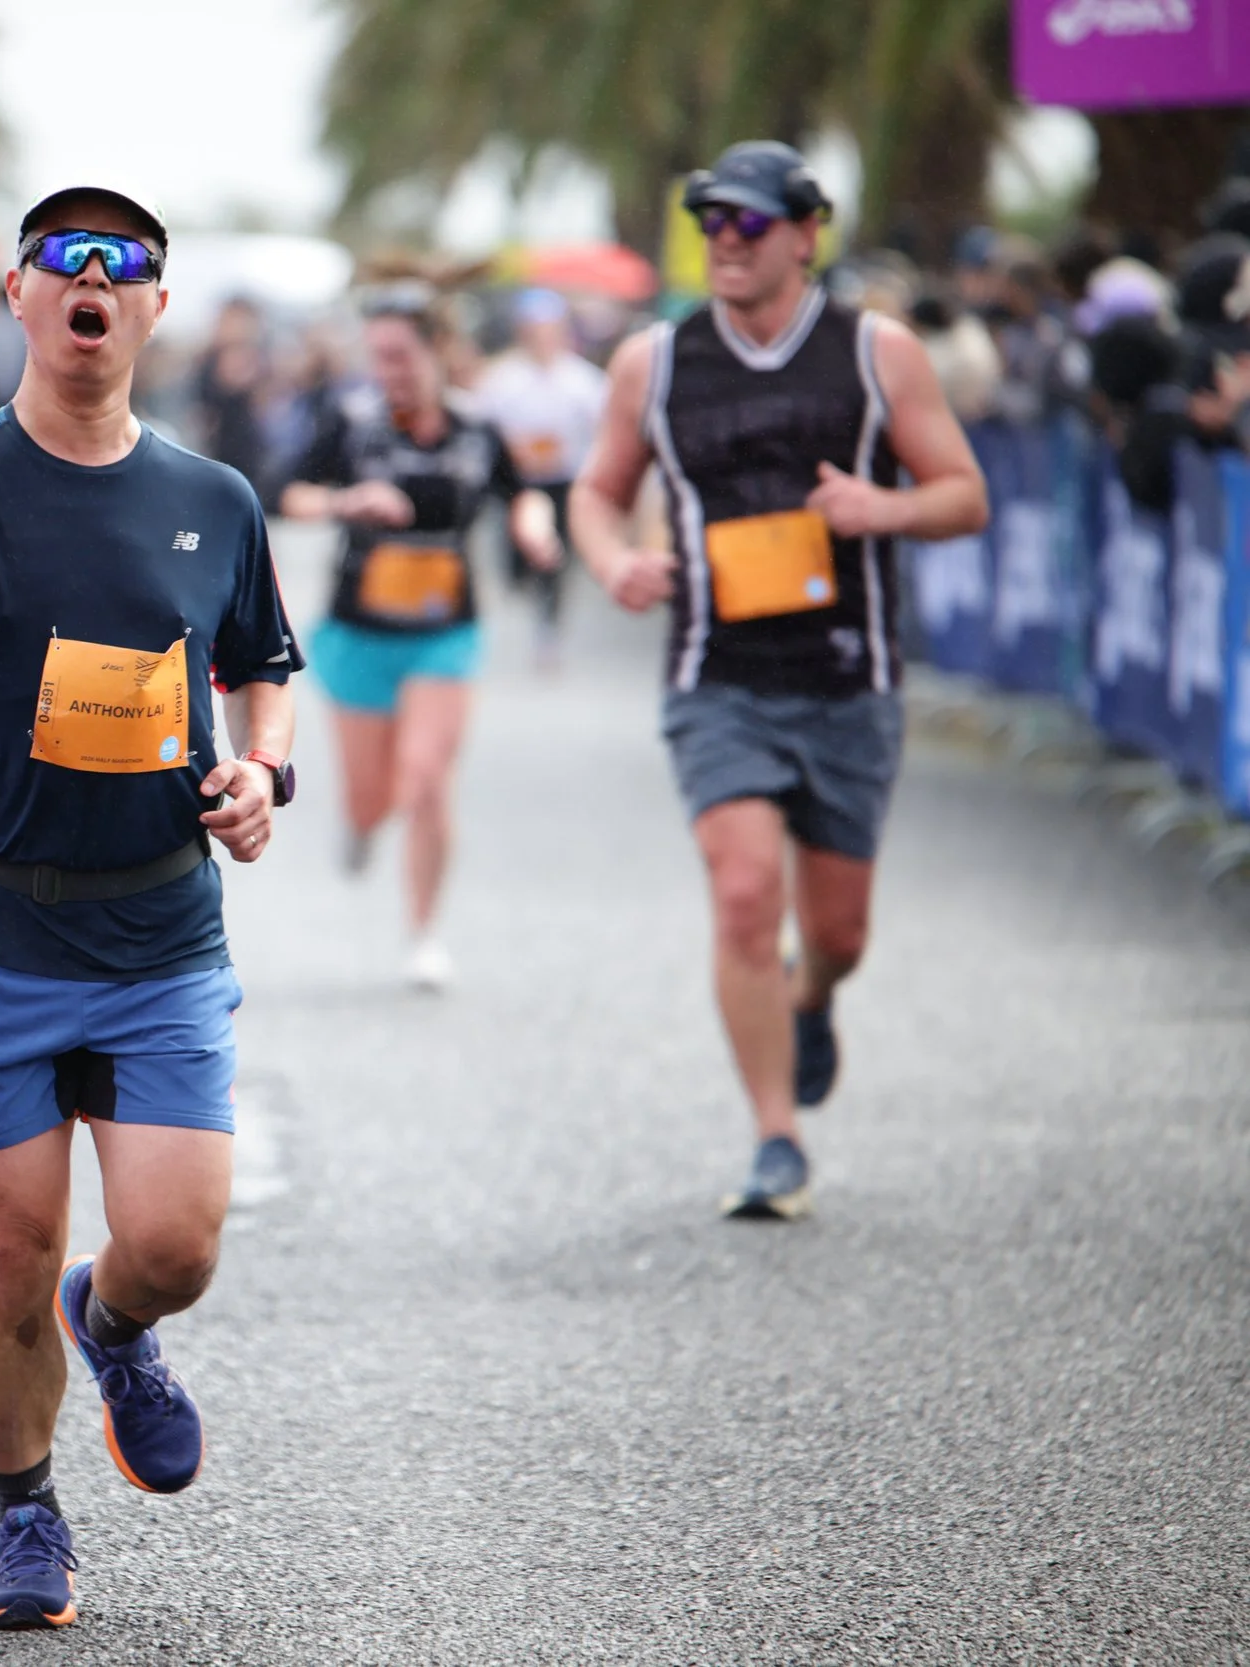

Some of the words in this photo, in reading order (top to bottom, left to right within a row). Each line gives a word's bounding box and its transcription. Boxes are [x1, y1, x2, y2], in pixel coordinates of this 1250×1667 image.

[70, 700, 144, 719] ANTHONY
[147, 704, 165, 718] LAI
[174, 682, 183, 724] 04691
